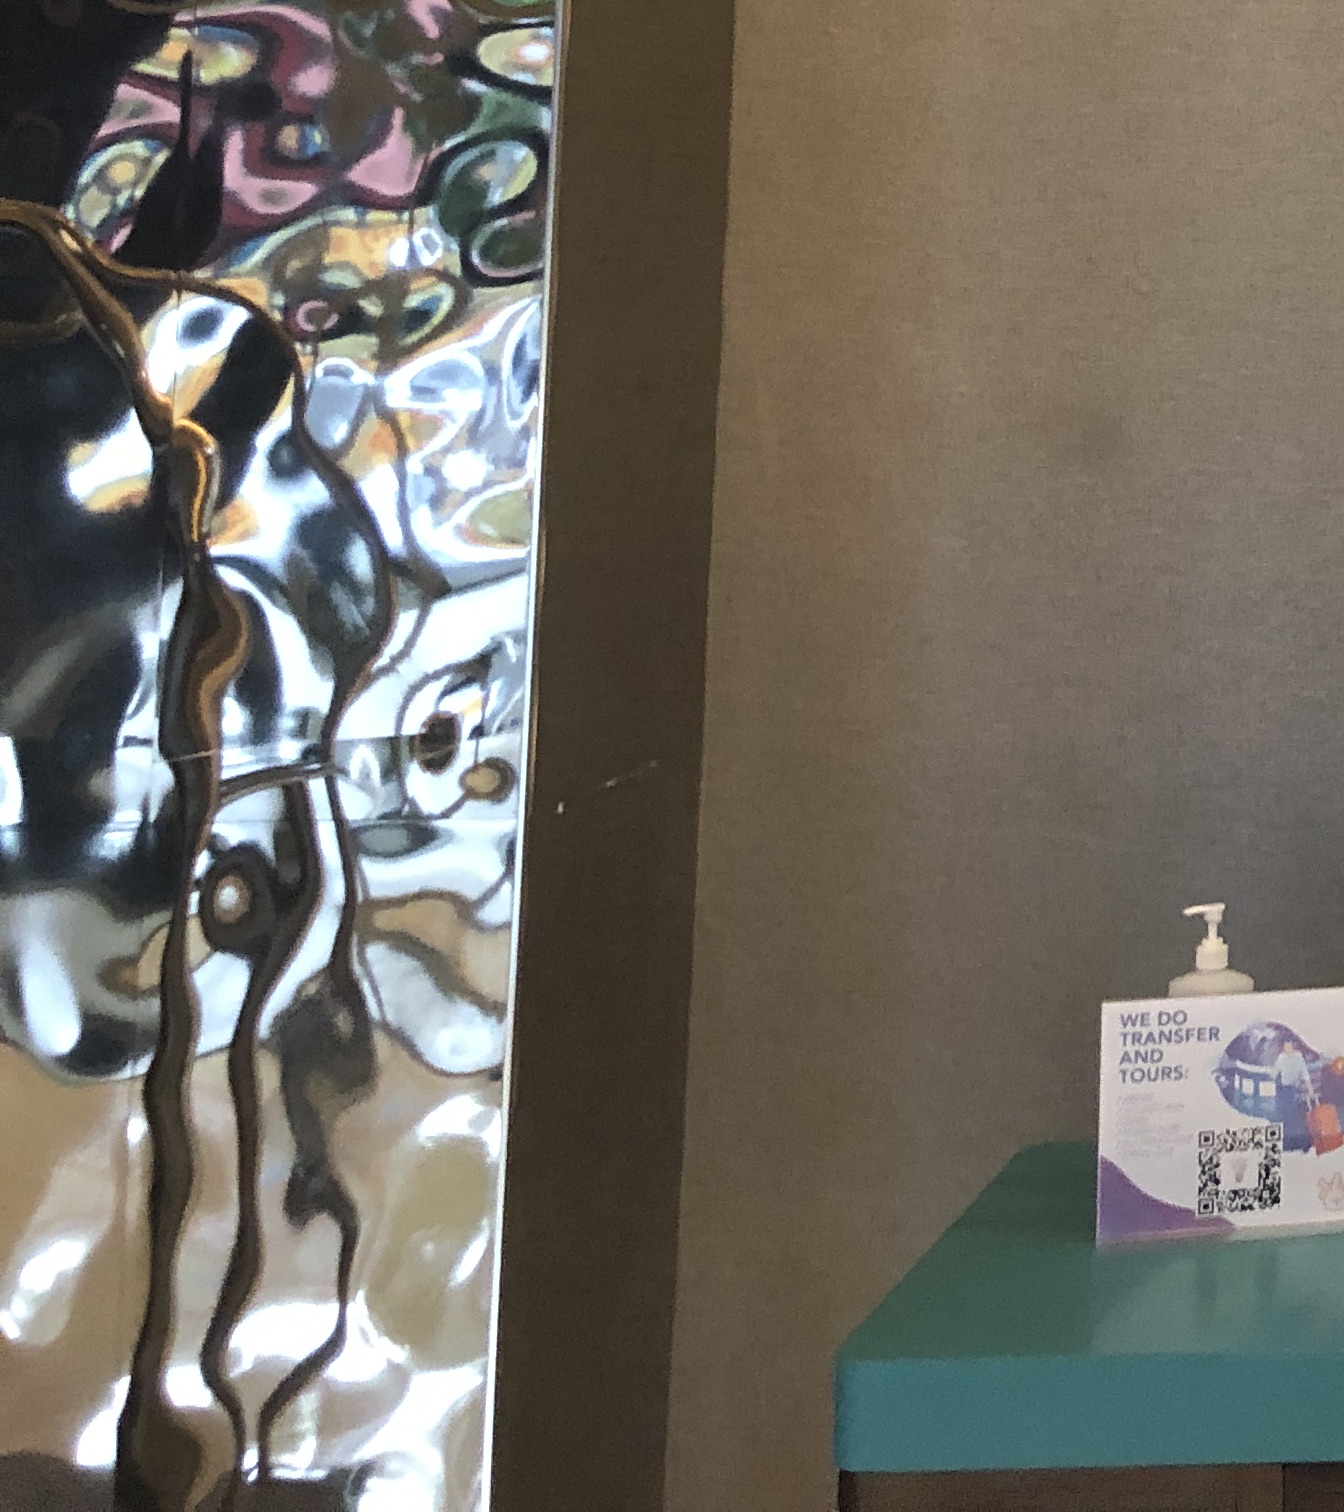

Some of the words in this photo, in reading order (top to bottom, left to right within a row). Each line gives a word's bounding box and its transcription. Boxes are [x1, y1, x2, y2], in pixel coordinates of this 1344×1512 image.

[1119, 1011, 1151, 1028] WE
[1157, 1010, 1188, 1026] DO
[1119, 1026, 1220, 1046] TRANSFER
[1119, 1048, 1164, 1065] AND
